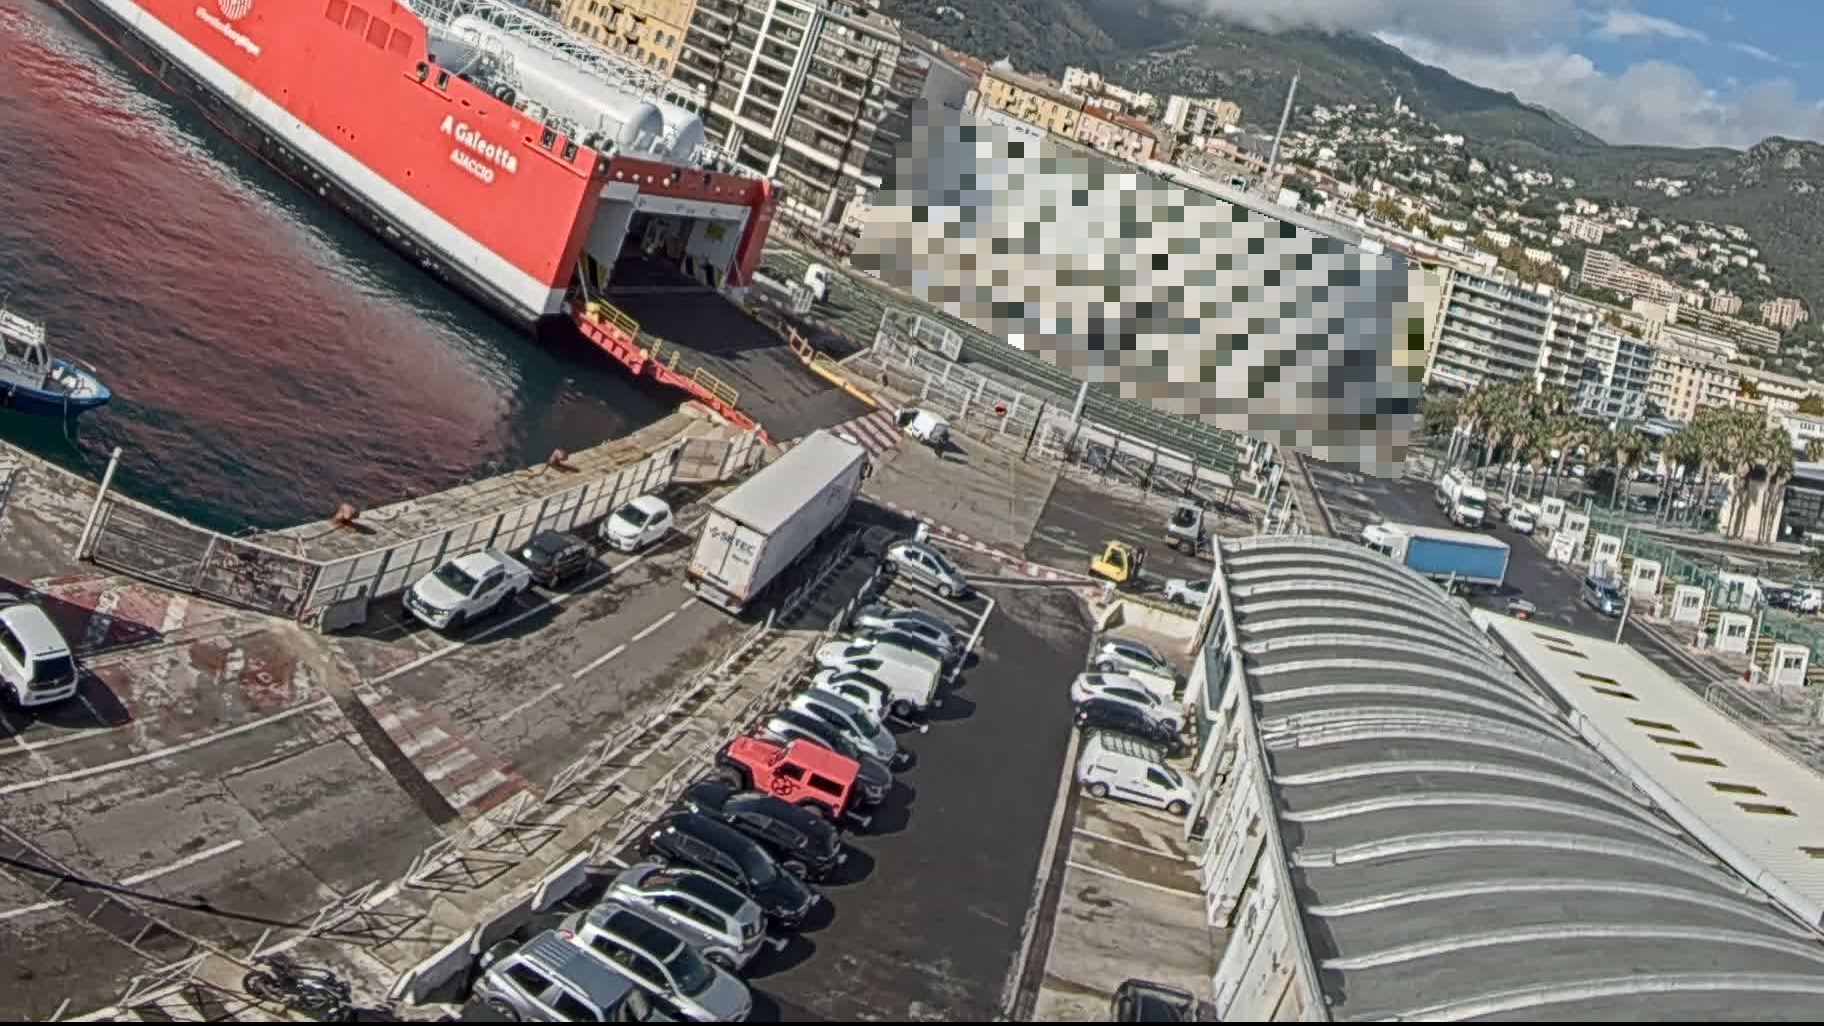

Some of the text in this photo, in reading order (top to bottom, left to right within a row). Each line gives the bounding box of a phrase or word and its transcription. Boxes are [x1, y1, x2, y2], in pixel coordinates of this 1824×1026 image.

[440, 115, 518, 174] A Galeotta
[449, 150, 495, 183] AJACCIO
